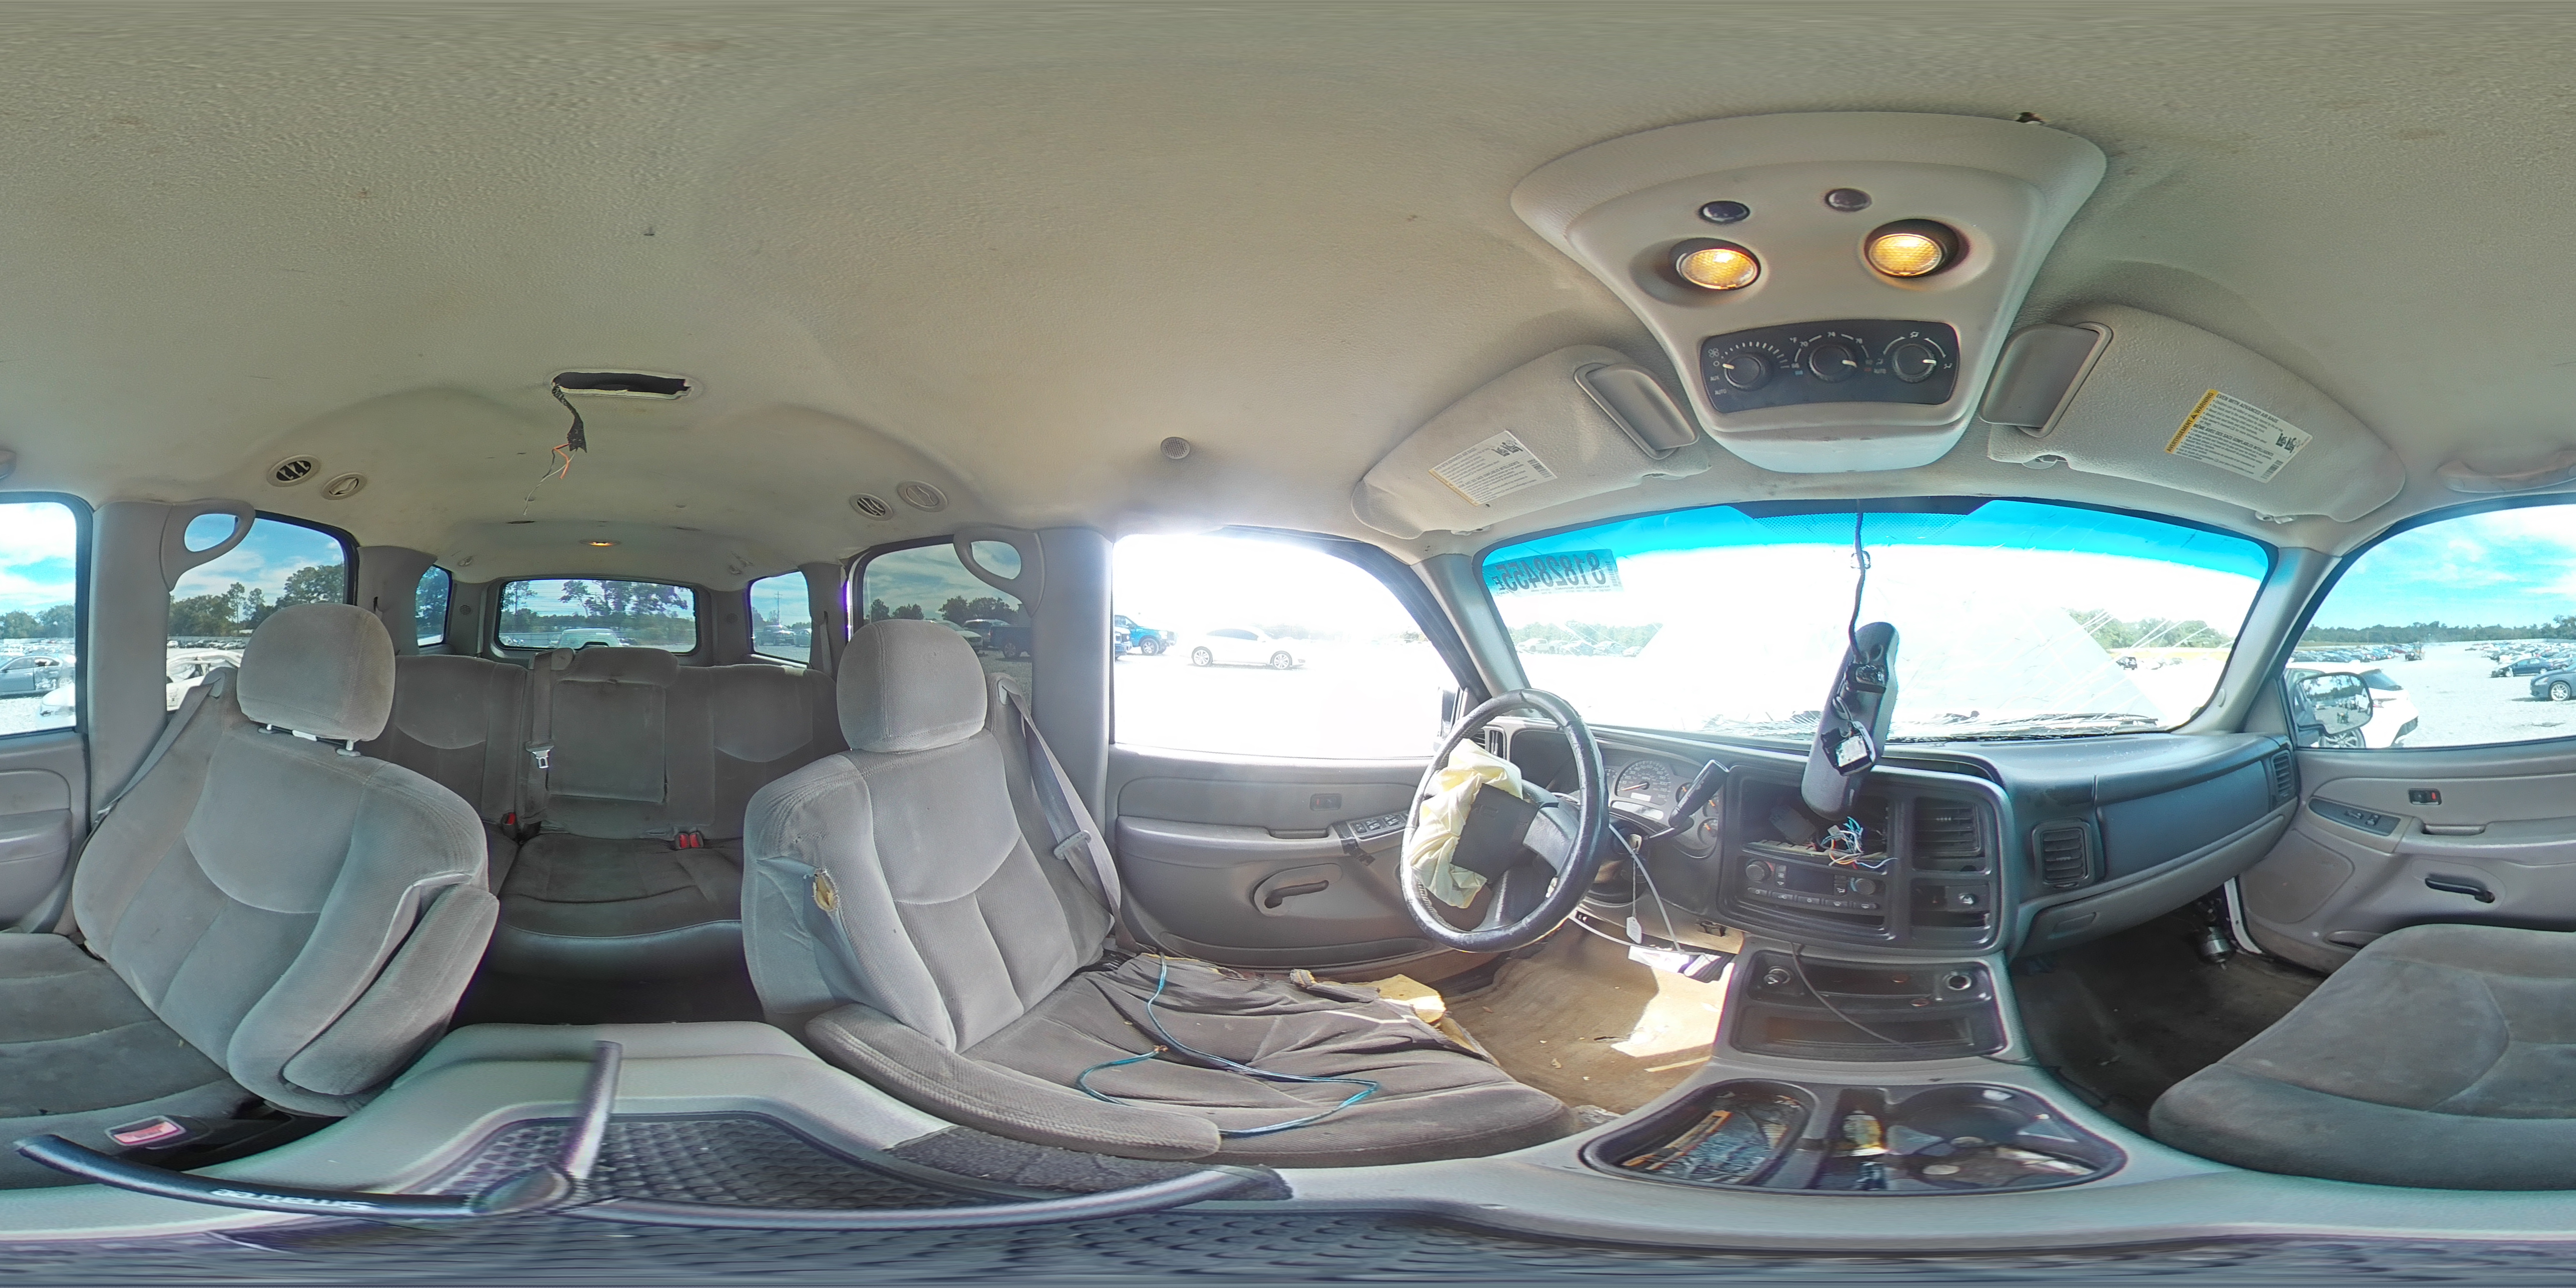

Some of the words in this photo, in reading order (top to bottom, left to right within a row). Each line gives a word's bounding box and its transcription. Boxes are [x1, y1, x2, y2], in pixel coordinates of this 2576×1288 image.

[2216, 393, 2228, 401] EVEN
[2167, 420, 2193, 453] AVERTISSEMENT
[2195, 392, 2214, 414] WARNING
